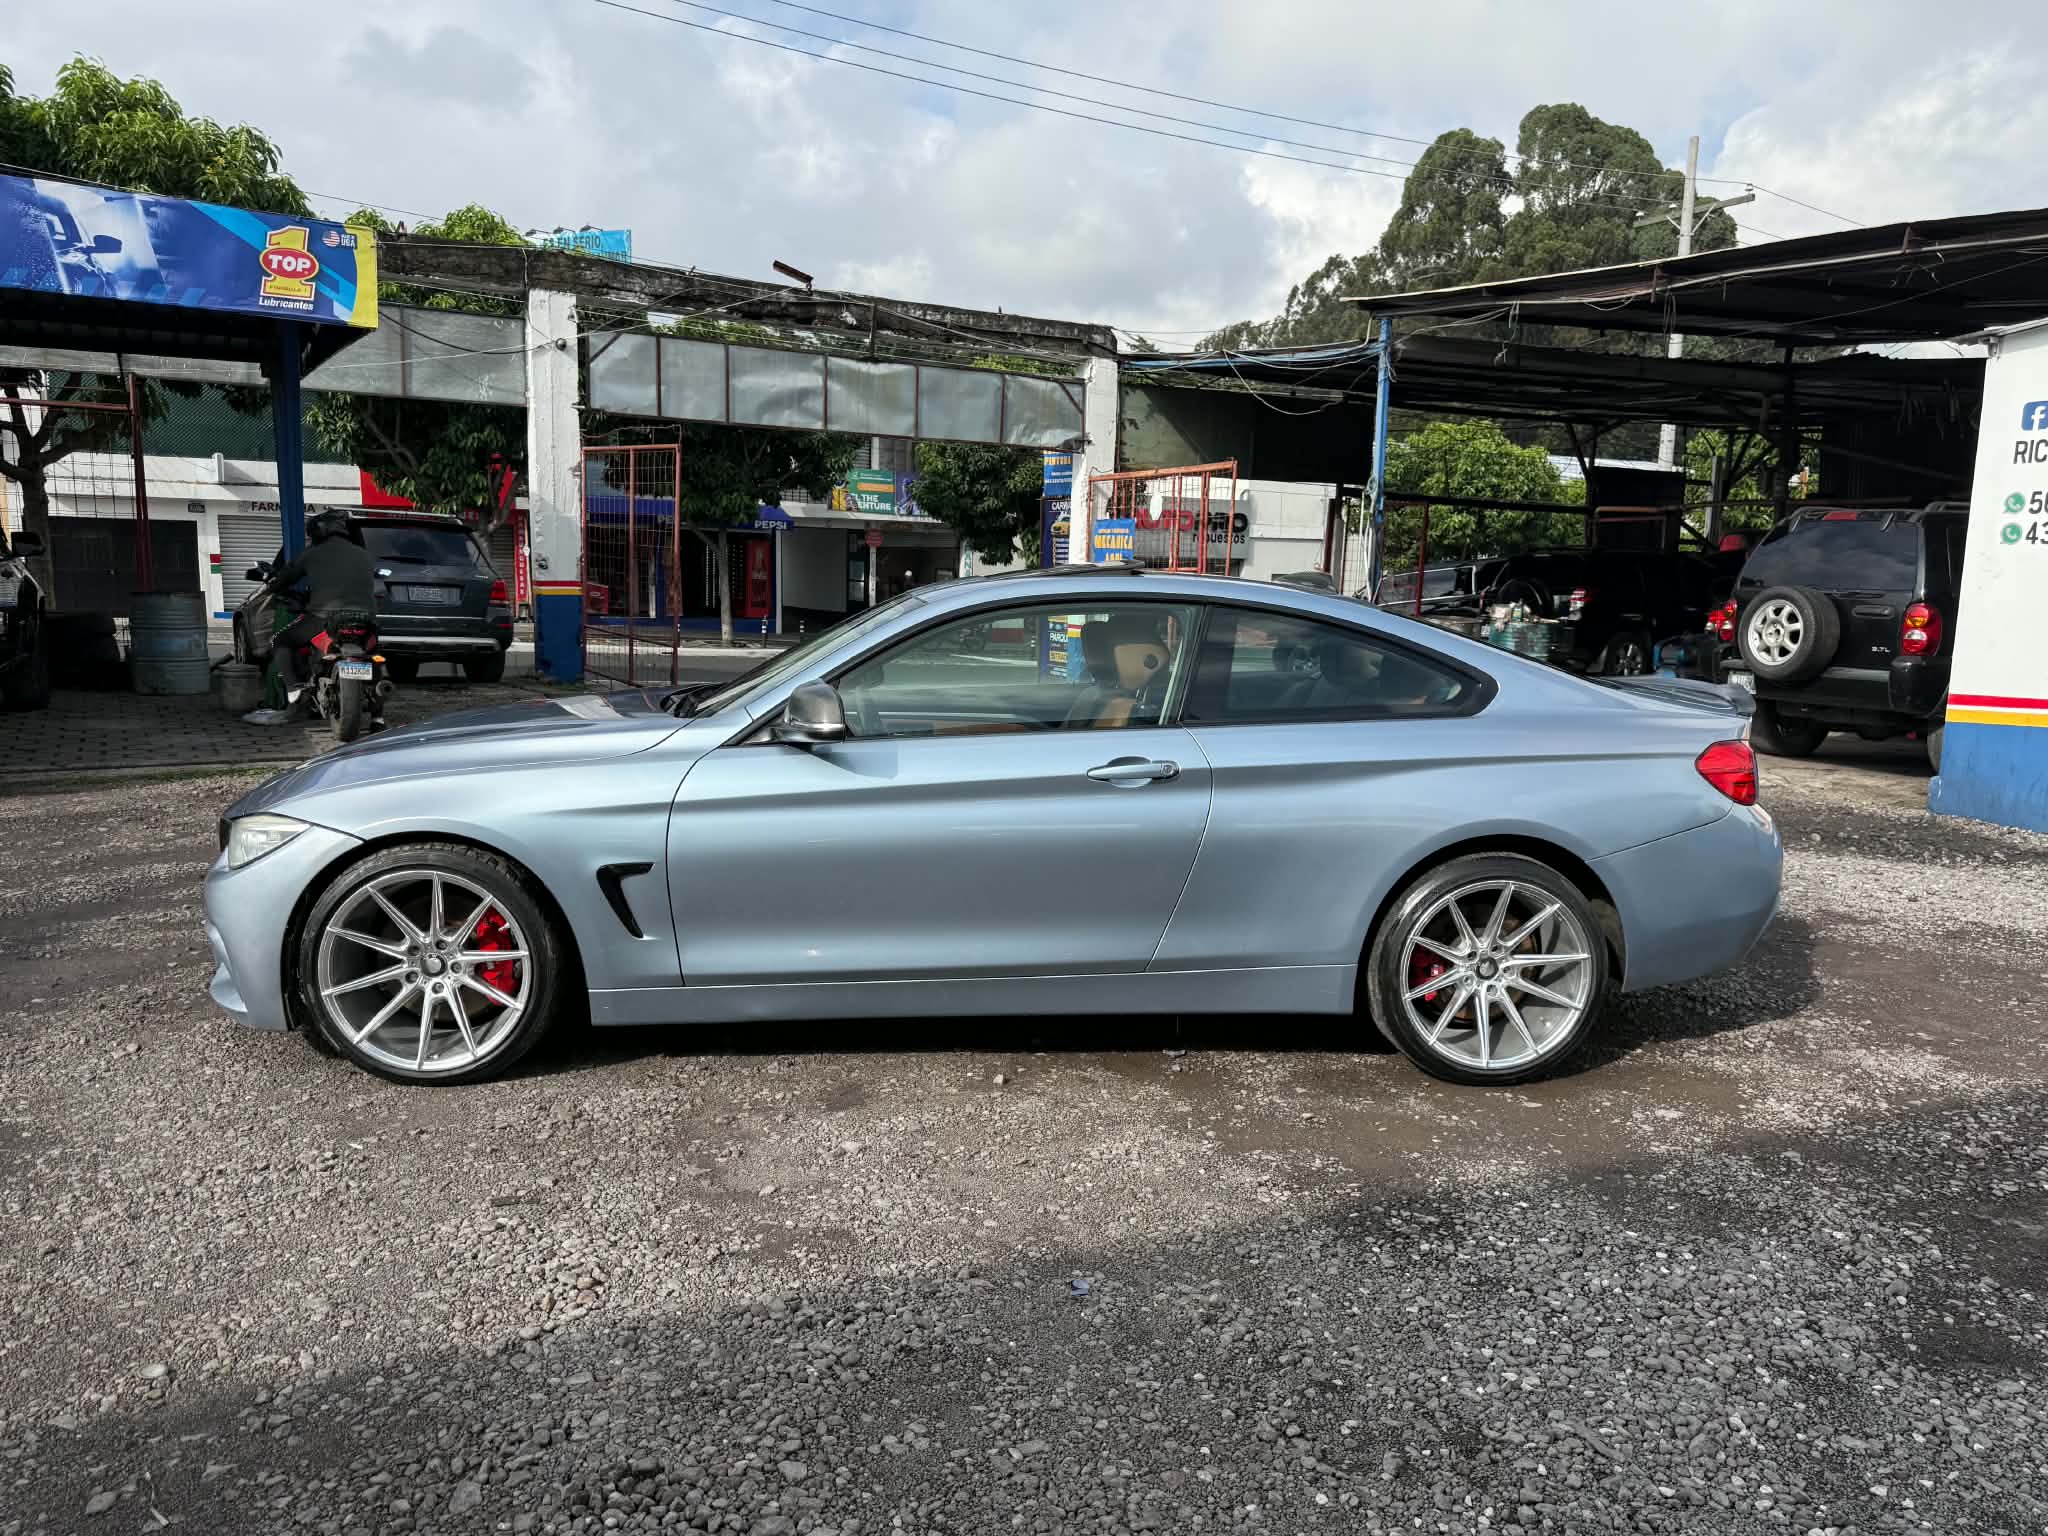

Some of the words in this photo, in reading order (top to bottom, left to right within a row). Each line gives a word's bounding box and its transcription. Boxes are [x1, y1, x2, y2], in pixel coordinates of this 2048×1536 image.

[268, 254, 312, 273] TOP
[259, 297, 314, 311] Lubricantes
[861, 493, 880, 502] THE
[754, 519, 787, 530] PEPSI
